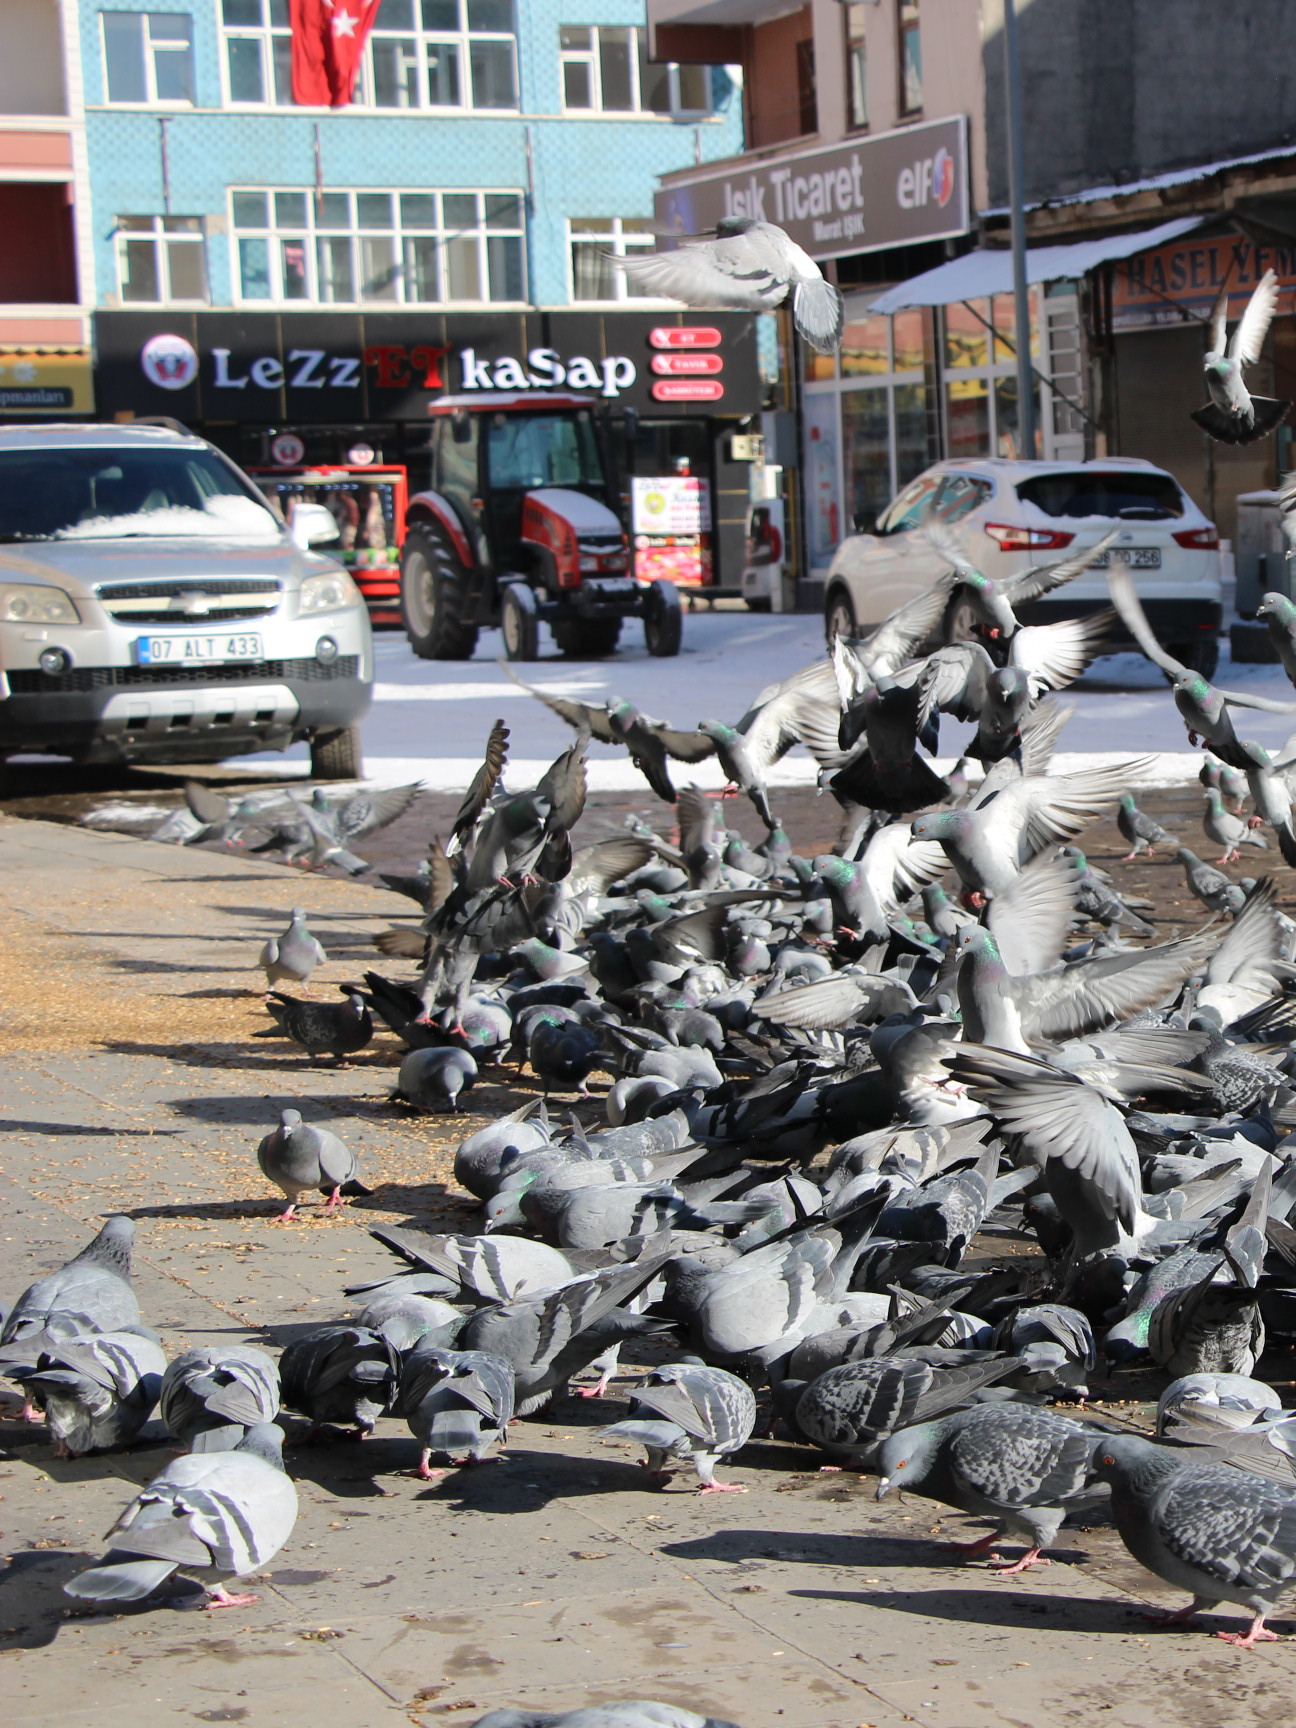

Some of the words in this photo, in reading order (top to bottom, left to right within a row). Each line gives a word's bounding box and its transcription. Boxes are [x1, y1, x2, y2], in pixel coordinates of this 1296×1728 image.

[770, 153, 864, 222] Ticaret
[897, 159, 931, 208] elf
[1127, 247, 1226, 296] HASEL
[460, 348, 637, 397] kaSap
[1135, 551, 1159, 563] 256
[152, 640, 172, 659] 07
[185, 638, 214, 658] ALT
[227, 637, 258, 656] 433
